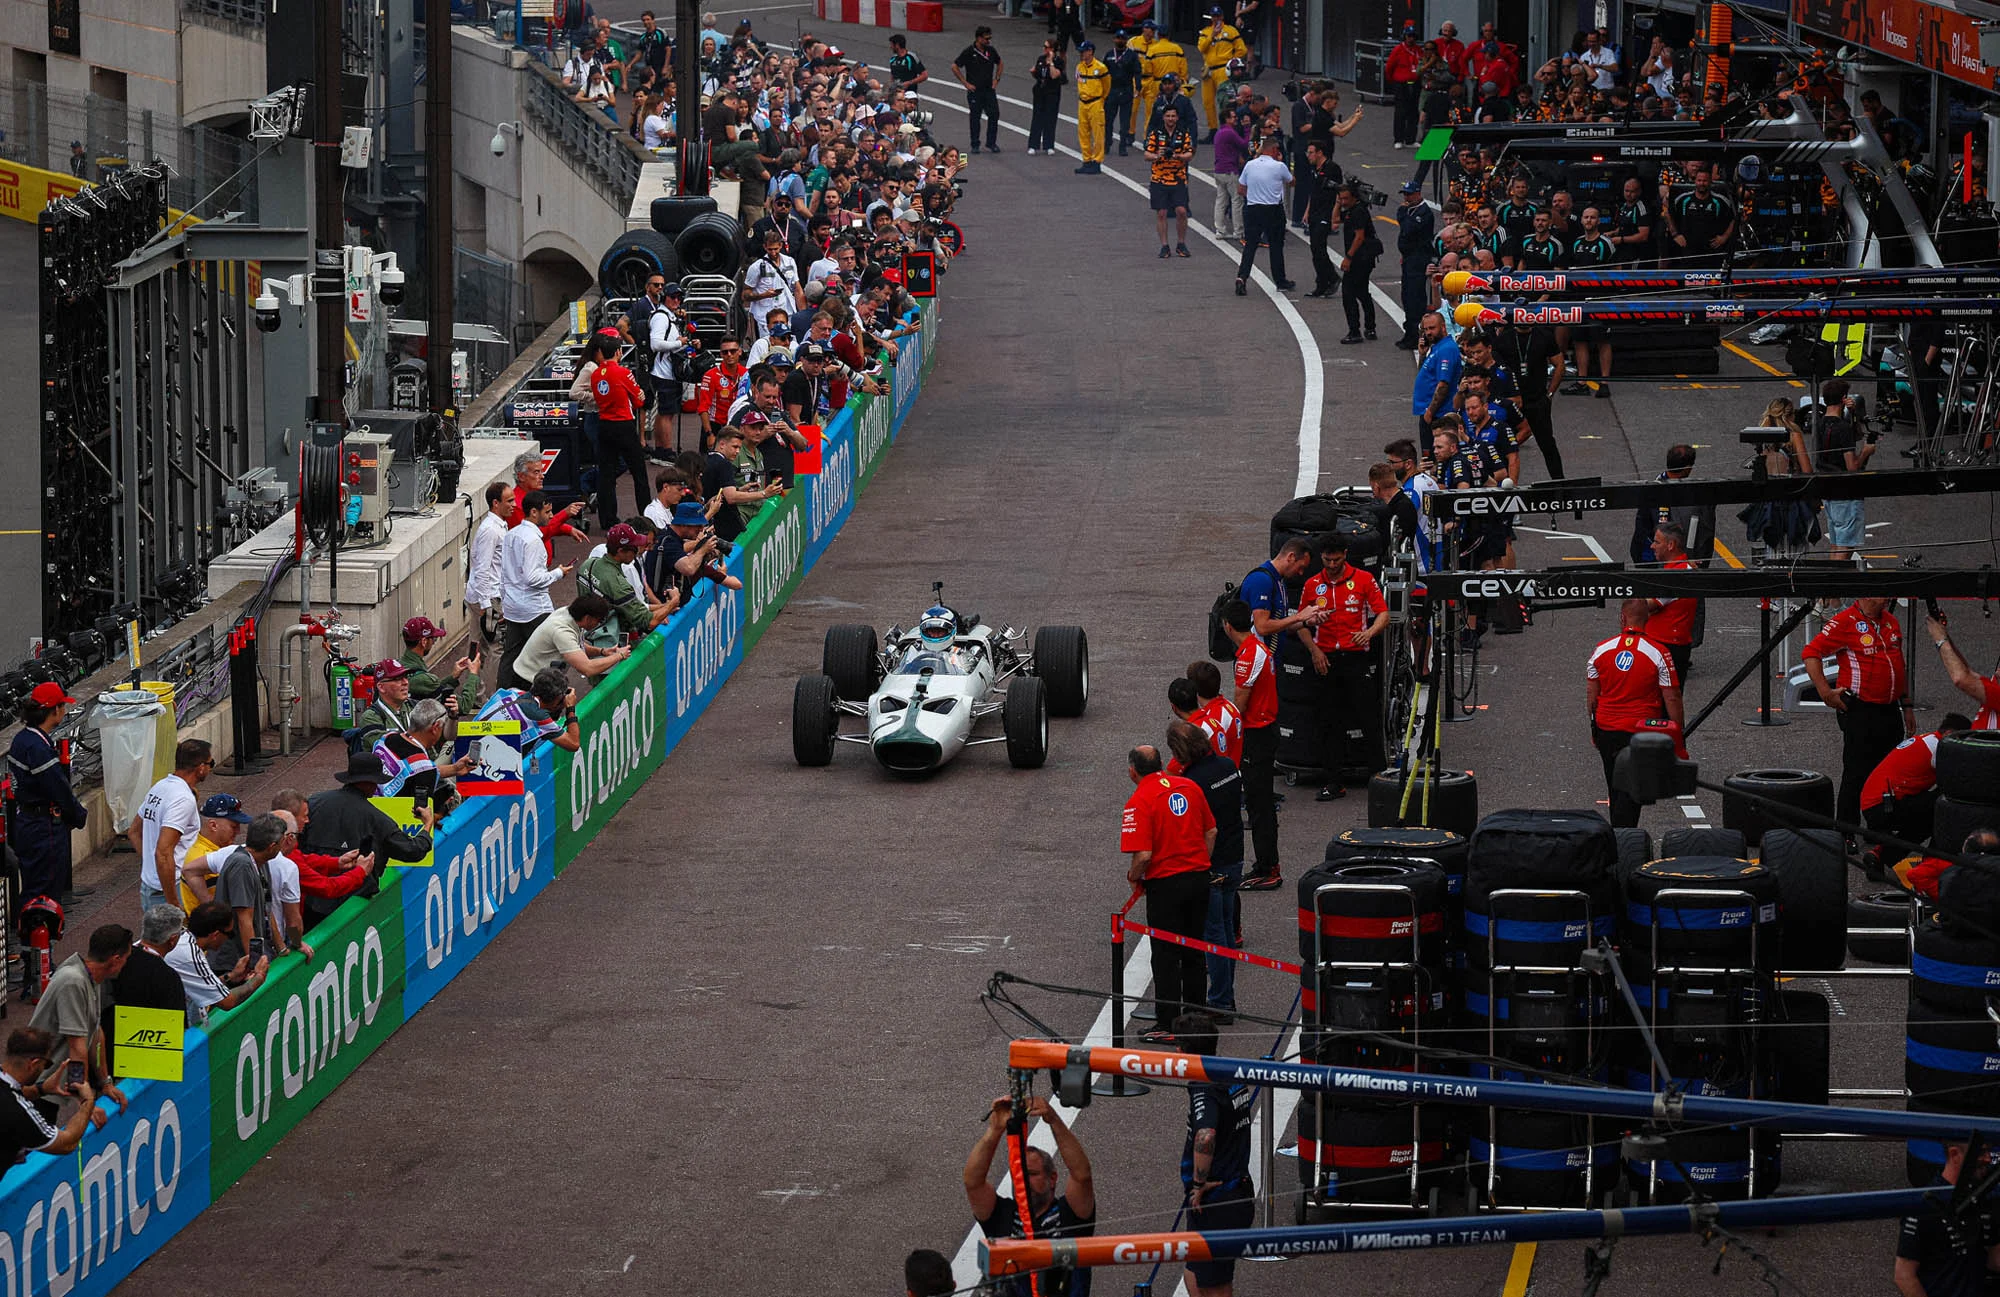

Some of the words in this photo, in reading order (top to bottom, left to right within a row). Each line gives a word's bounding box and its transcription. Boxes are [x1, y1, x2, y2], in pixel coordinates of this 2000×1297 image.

[1886, 30, 1908, 49] NORRIS
[1952, 32, 1960, 65] 81
[1566, 128, 1615, 137] Einhell
[1620, 147, 1672, 156] Einhell
[1530, 498, 1607, 512] LOGISTICS
[752, 504, 801, 624] aramco
[1549, 585, 1633, 597] LOGISTICS
[676, 590, 737, 718] aramco
[1617, 650, 1633, 670] hp
[571, 676, 655, 832] aramco
[425, 790, 538, 970] aramco
[1719, 917, 1739, 925] Left
[1721, 911, 1745, 919] Front
[1390, 927, 1409, 935] Left
[1563, 930, 1583, 938] Left
[128, 1029, 167, 1043] ART
[235, 925, 384, 1141] aramco
[1119, 1053, 1189, 1077] Gulf
[1247, 1067, 1322, 1086] ATLASSIAN
[1335, 1072, 1408, 1092] Williams
[1413, 1081, 1428, 1094] F1
[1434, 1082, 1478, 1097] TEAM
[1690, 1172, 1715, 1180] Right
[1113, 1240, 1190, 1264] Gulf
[1256, 1239, 1338, 1255] ATLASSIAN
[1352, 1232, 1432, 1249] Williams
[1437, 1233, 1453, 1245] F1
[1461, 1230, 1506, 1244] TEAM
